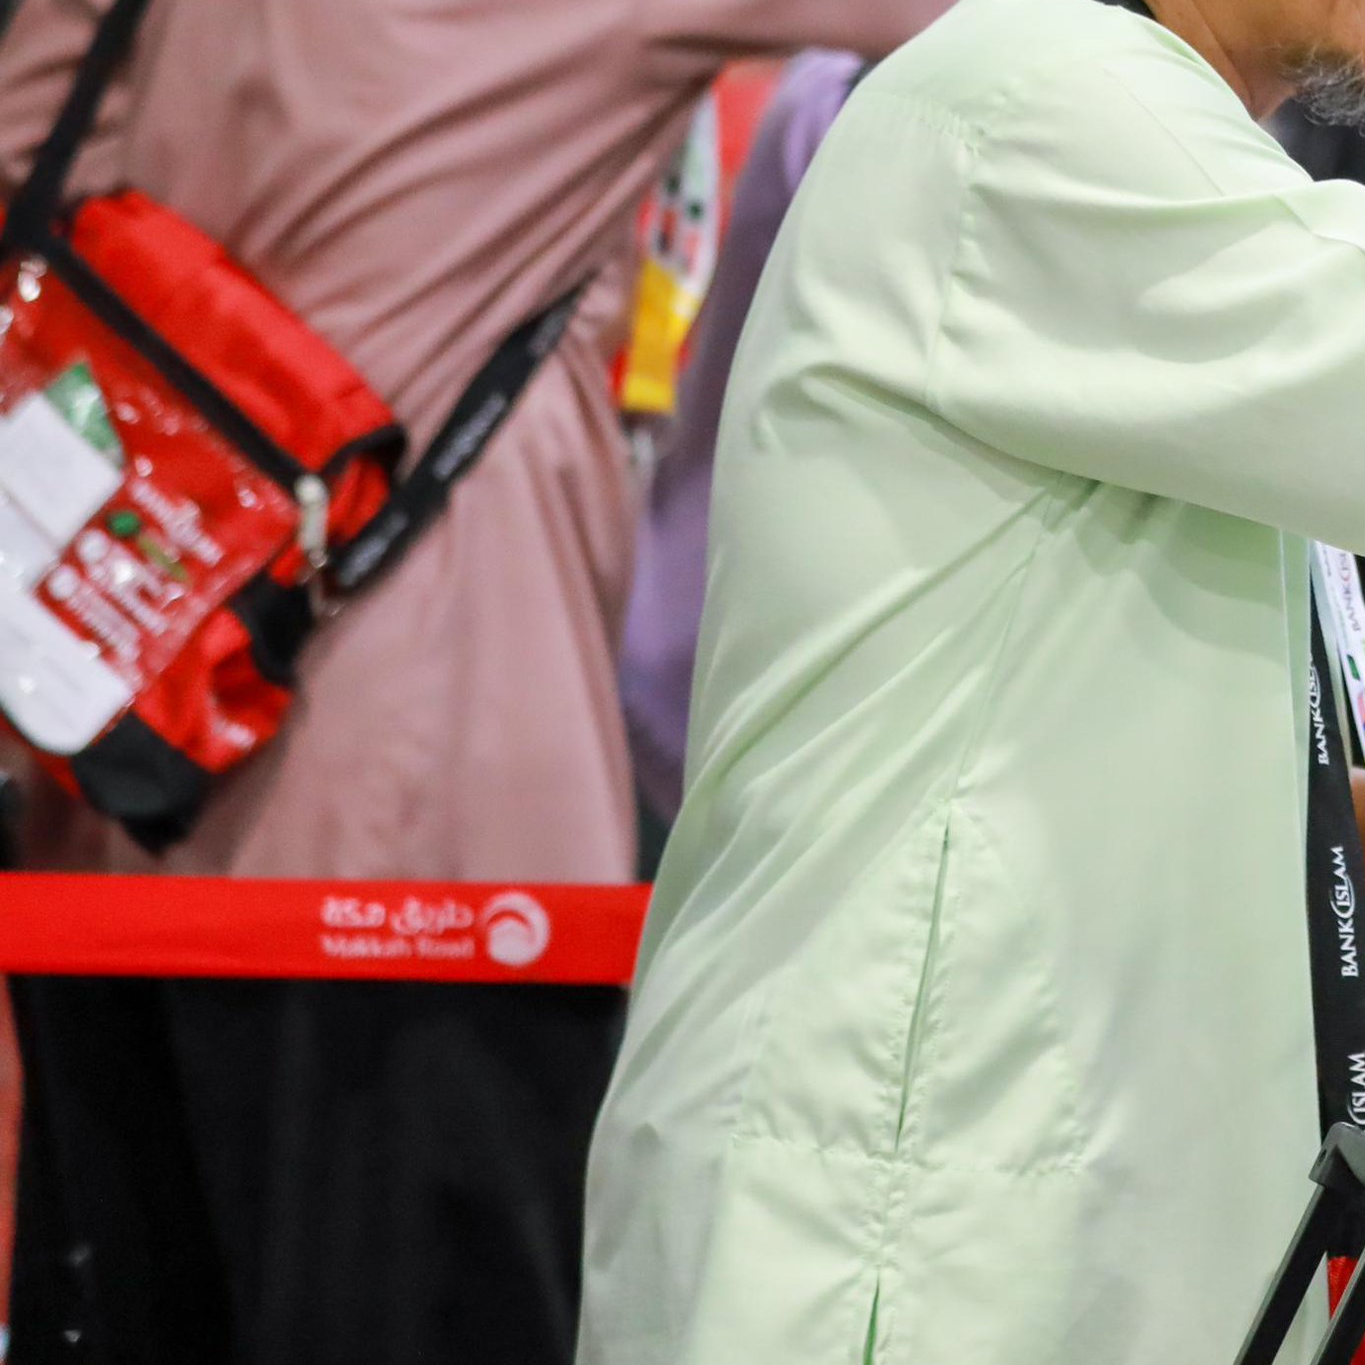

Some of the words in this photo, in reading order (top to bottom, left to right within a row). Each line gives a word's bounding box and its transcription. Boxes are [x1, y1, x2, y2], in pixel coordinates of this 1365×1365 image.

[1342, 585, 1362, 632] BANK
[1310, 708, 1330, 766] BANK
[1330, 845, 1352, 908] ISLAM
[1338, 918, 1359, 978] BANK
